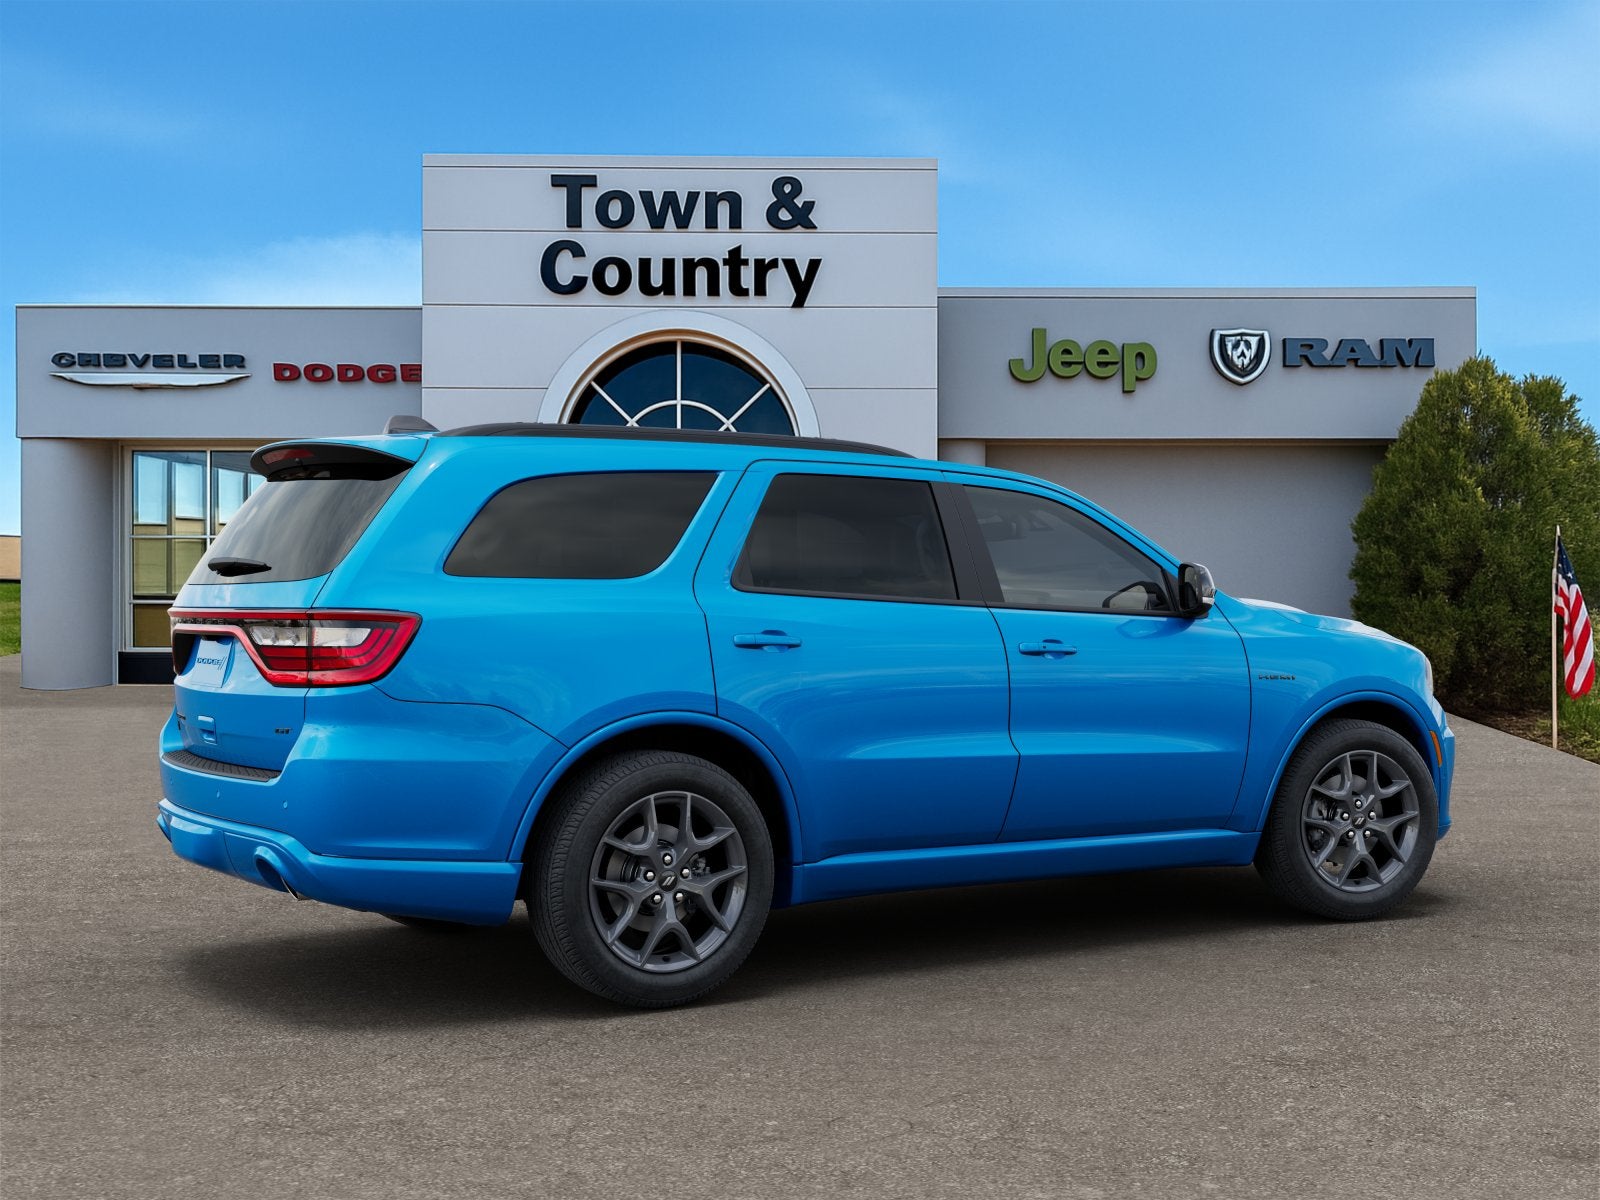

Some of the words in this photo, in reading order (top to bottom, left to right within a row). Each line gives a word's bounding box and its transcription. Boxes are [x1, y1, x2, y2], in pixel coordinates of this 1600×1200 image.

[550, 174, 743, 229] Town
[765, 176, 818, 230] &
[540, 240, 822, 308] Country
[273, 362, 422, 383] DODGE
[1009, 328, 1158, 393] Jeep
[1282, 337, 1436, 367] RAM
